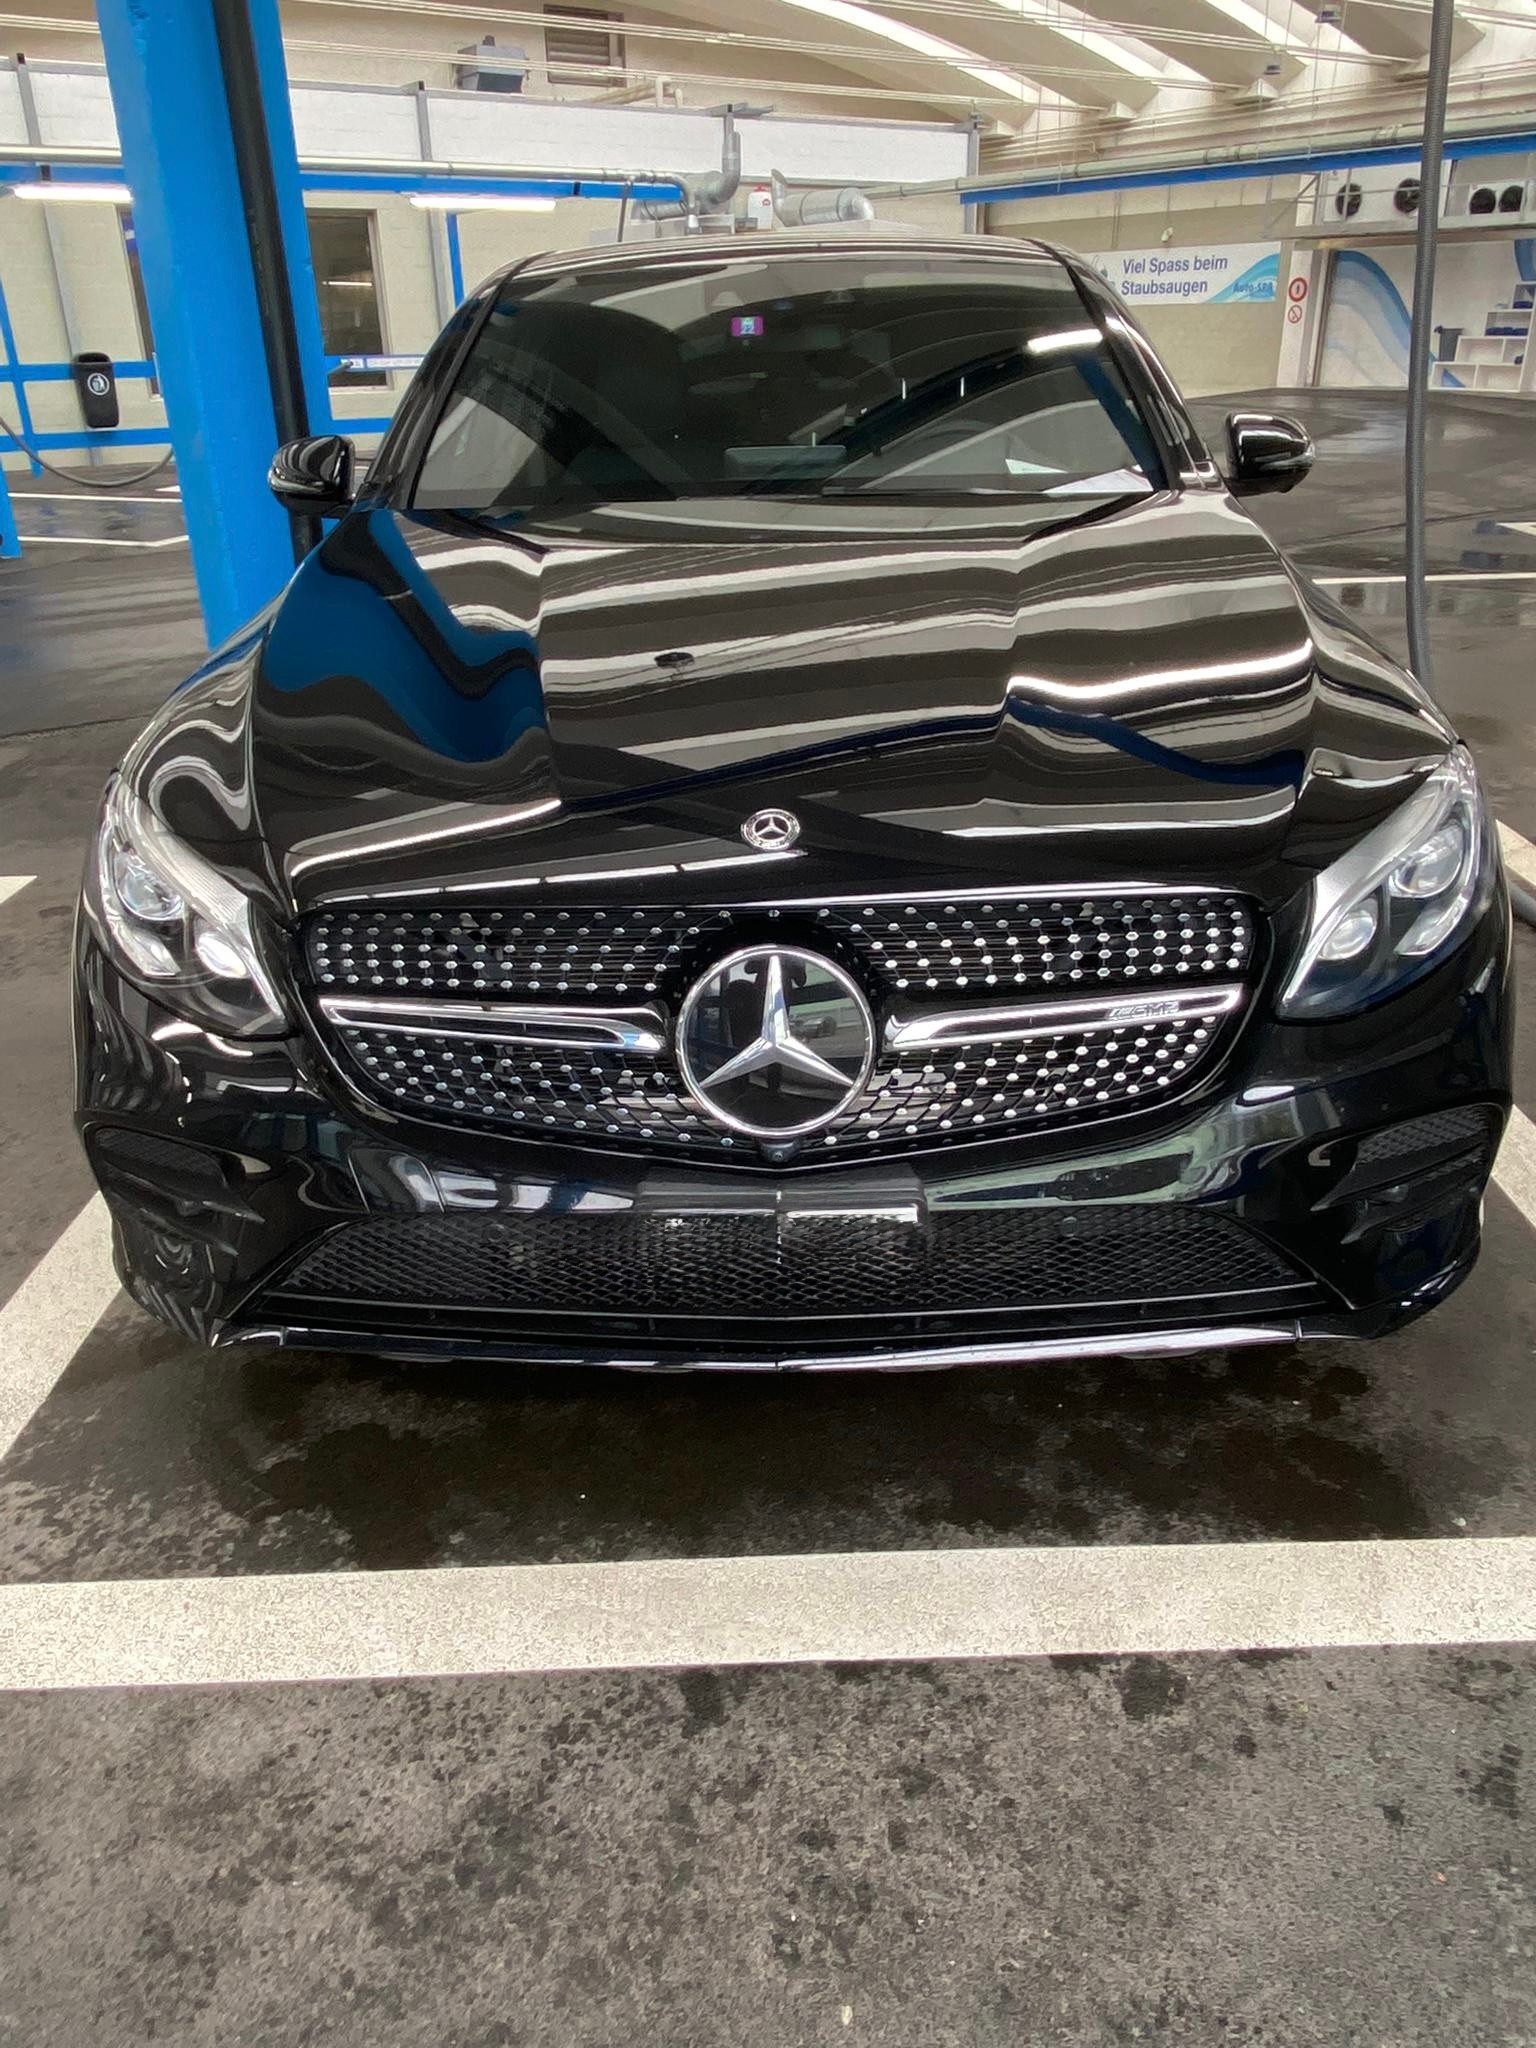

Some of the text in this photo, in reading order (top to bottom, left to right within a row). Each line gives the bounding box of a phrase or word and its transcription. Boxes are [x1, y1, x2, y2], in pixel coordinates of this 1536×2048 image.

[1123, 254, 1228, 276] Viel Spass beim
[1121, 279, 1208, 297] Staubsaugen
